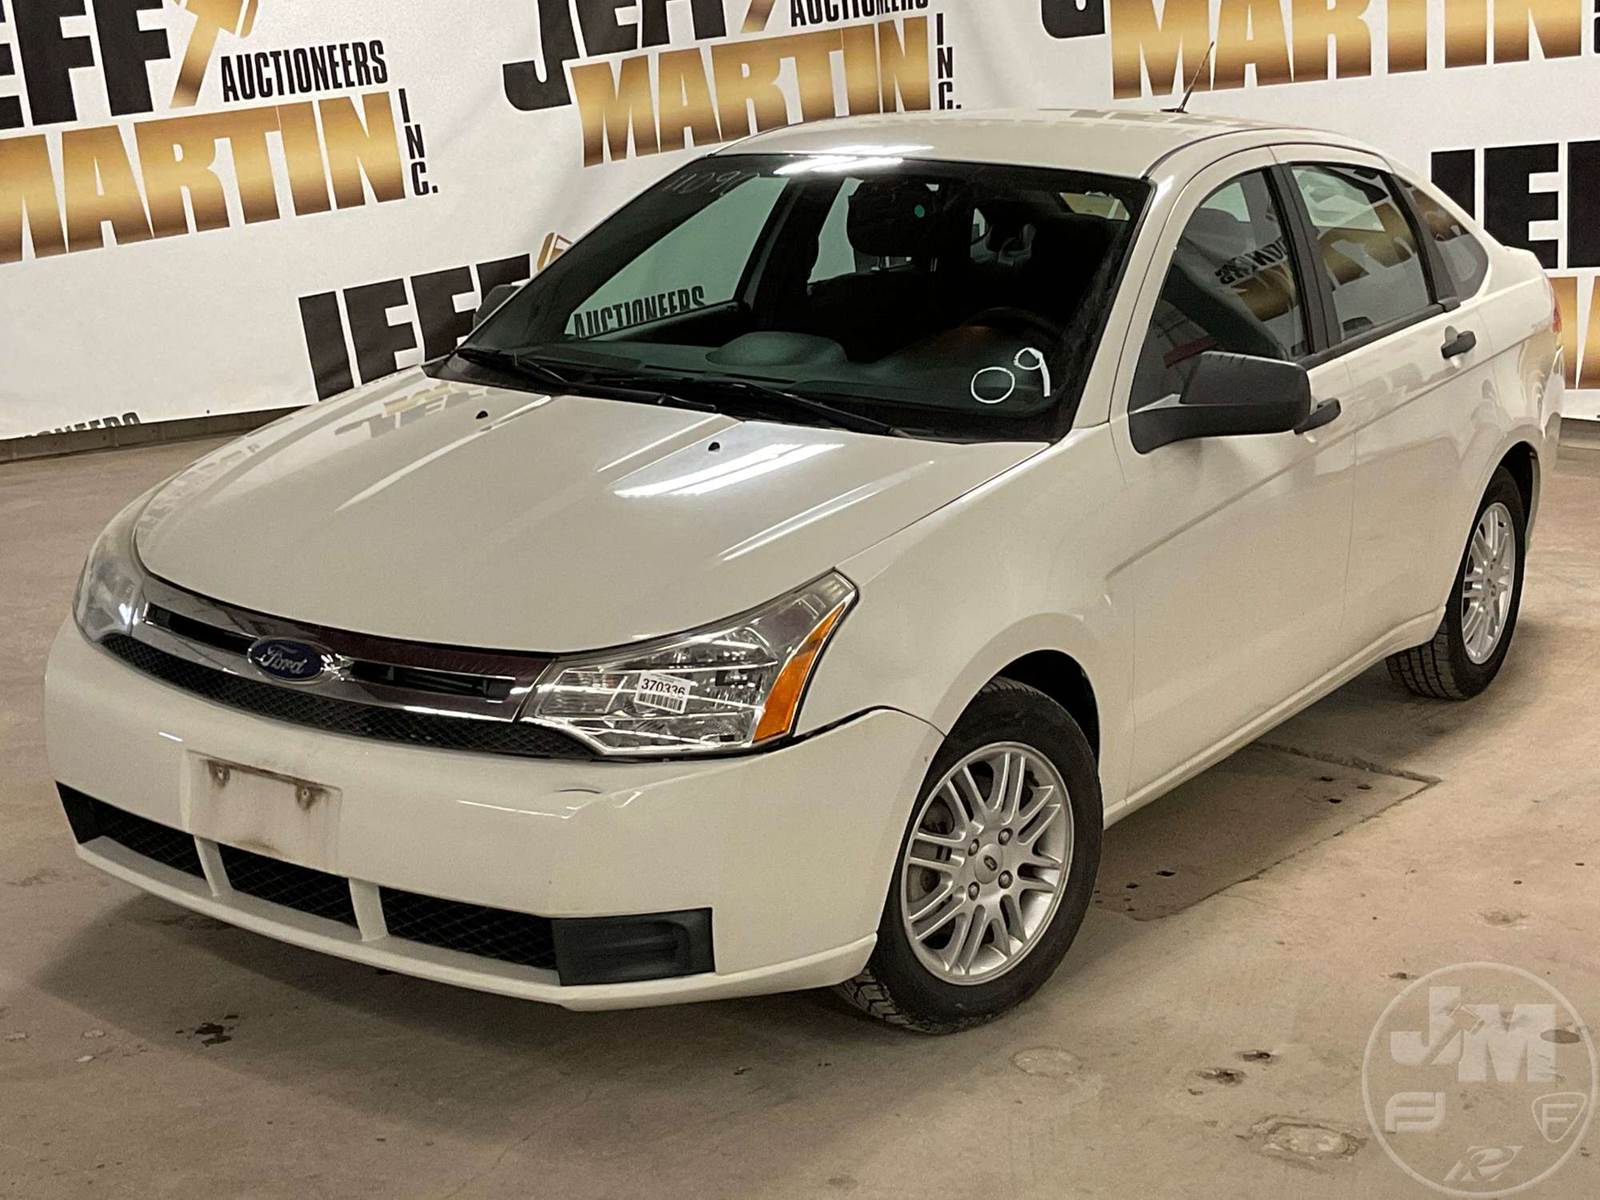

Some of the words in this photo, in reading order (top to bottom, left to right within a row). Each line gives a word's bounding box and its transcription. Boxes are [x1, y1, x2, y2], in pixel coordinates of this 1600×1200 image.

[220, 40, 388, 102] AUCTIONEERS
[571, 16, 931, 168] MARTIN
[573, 286, 705, 337] AUCTIONEERS
[255, 644, 308, 675] Ford
[641, 678, 686, 698] 370336
